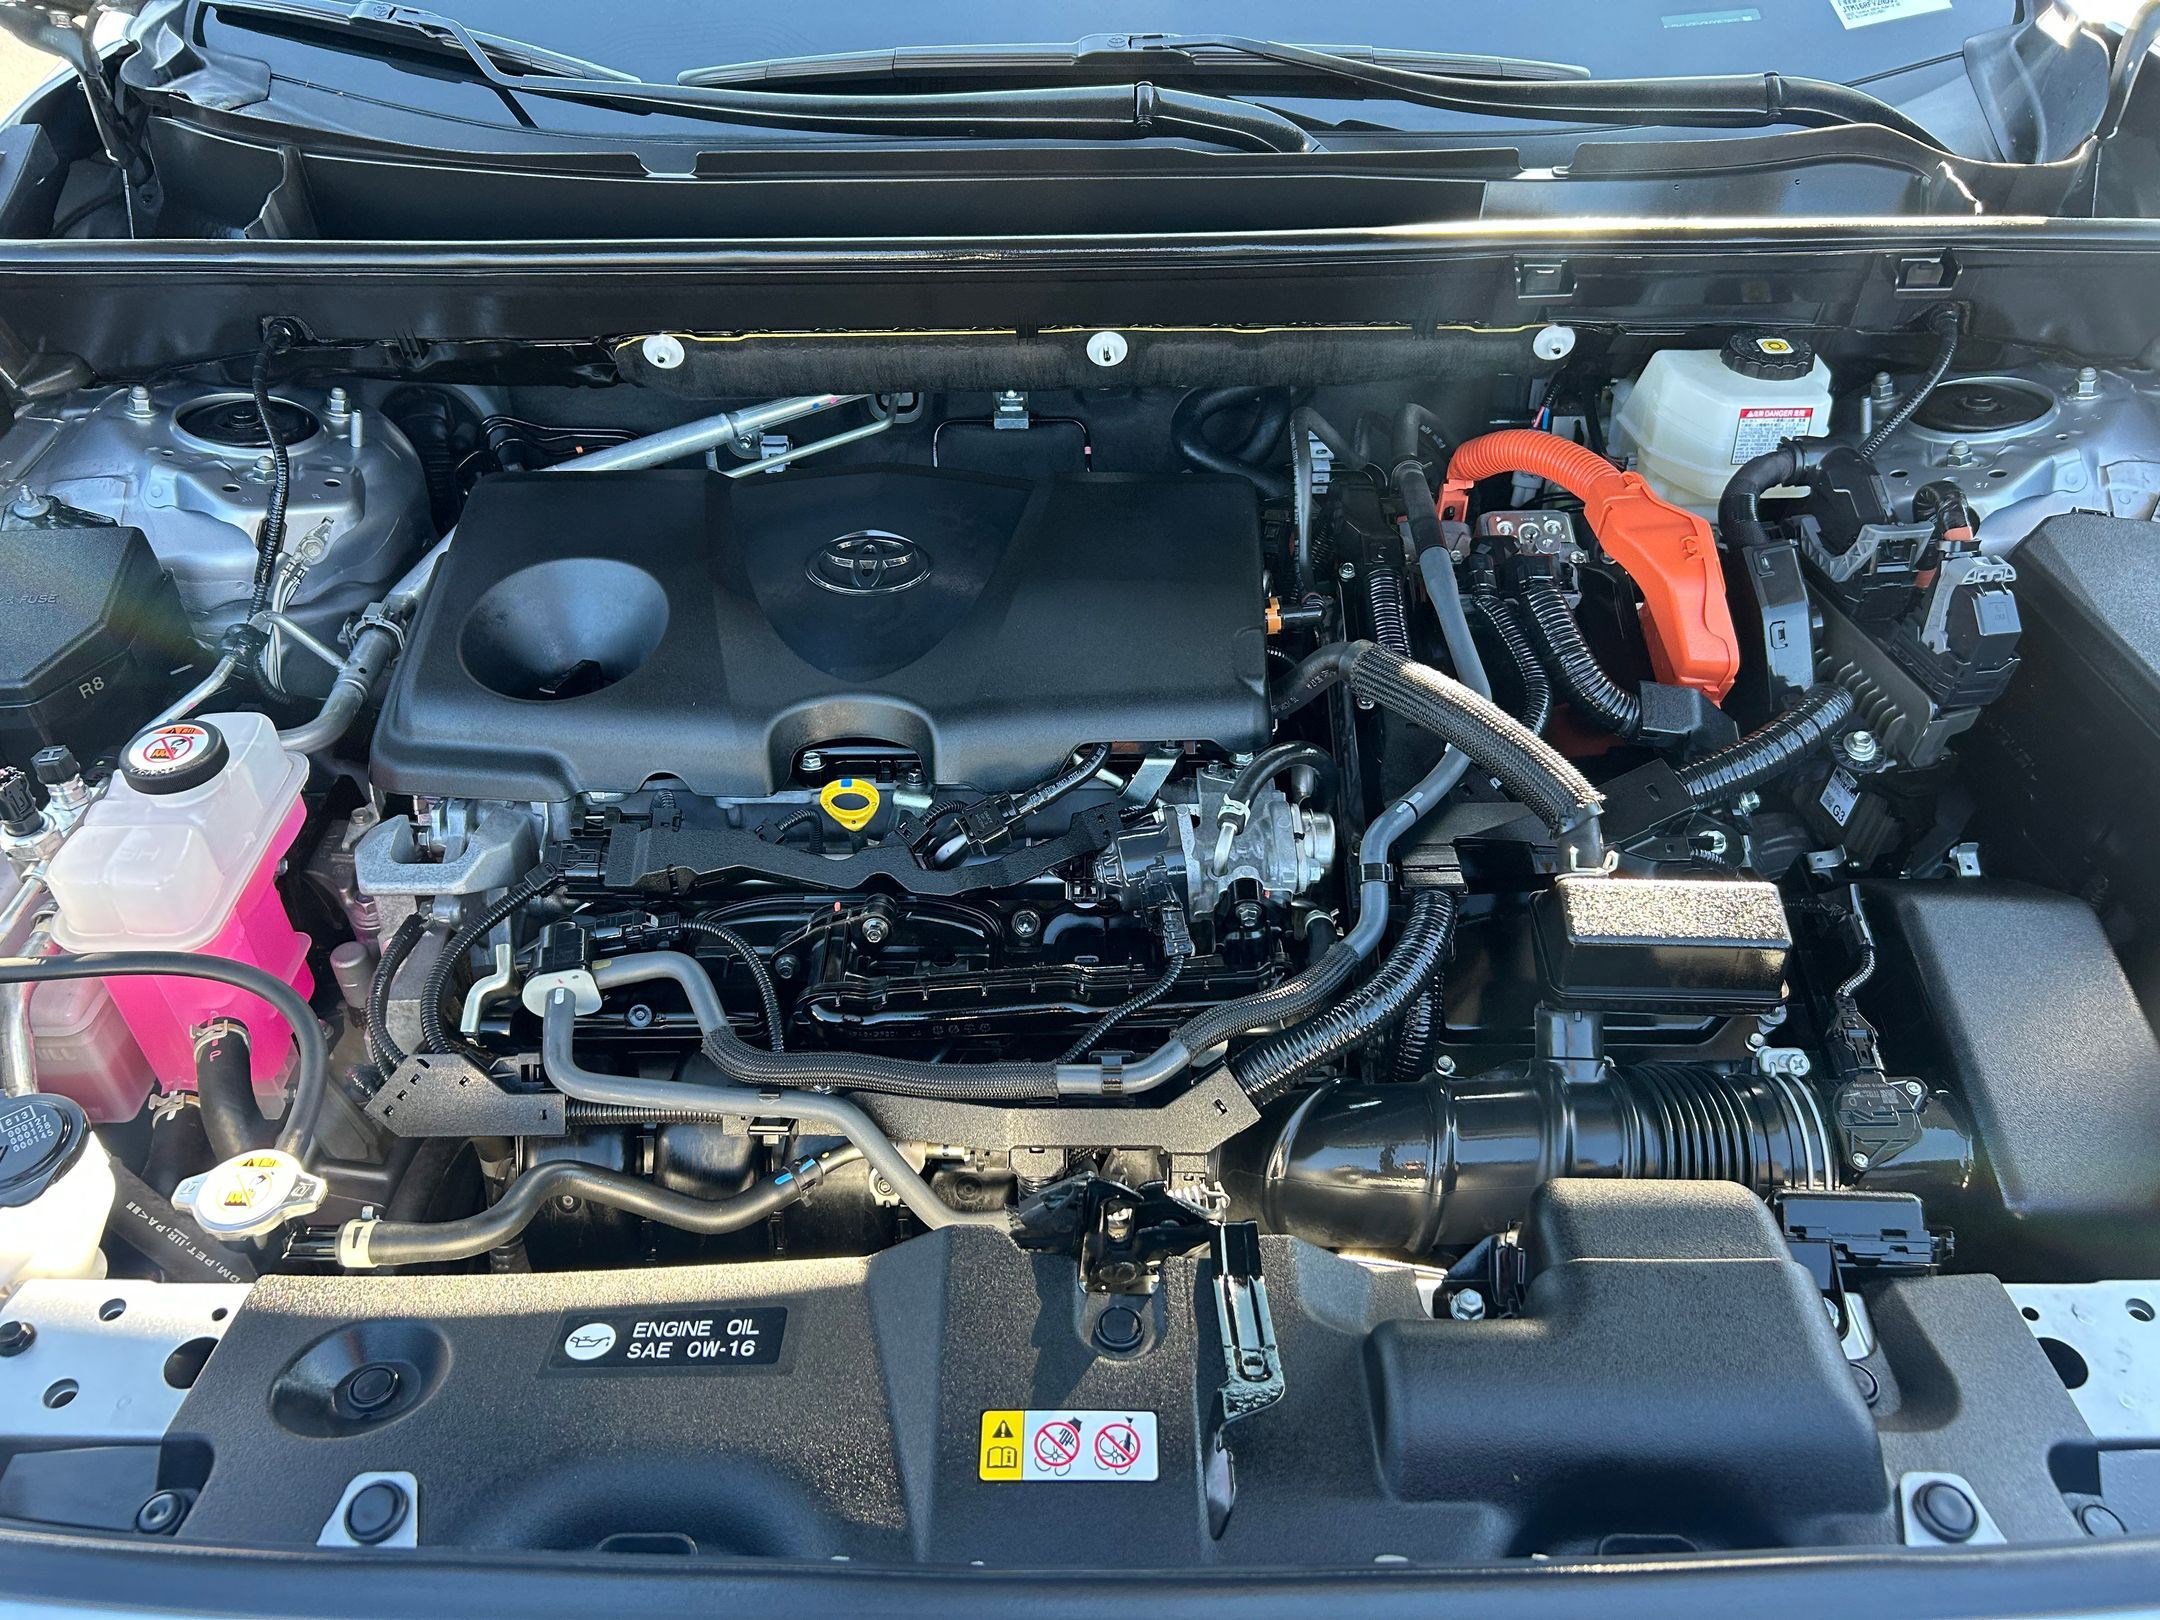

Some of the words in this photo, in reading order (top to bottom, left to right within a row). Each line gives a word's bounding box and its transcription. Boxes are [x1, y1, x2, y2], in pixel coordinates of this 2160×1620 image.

[1764, 409, 1793, 417] DANGER
[19, 593, 59, 604] FUSE
[78, 676, 104, 699] R8
[1832, 804, 1846, 822] G3
[7, 1113, 48, 1138] 000127
[10, 1121, 51, 1145] 000128
[12, 1129, 54, 1152] 000145
[632, 1319, 713, 1338] ENGINE
[726, 1318, 760, 1336] OIL
[626, 1341, 673, 1359] SAE
